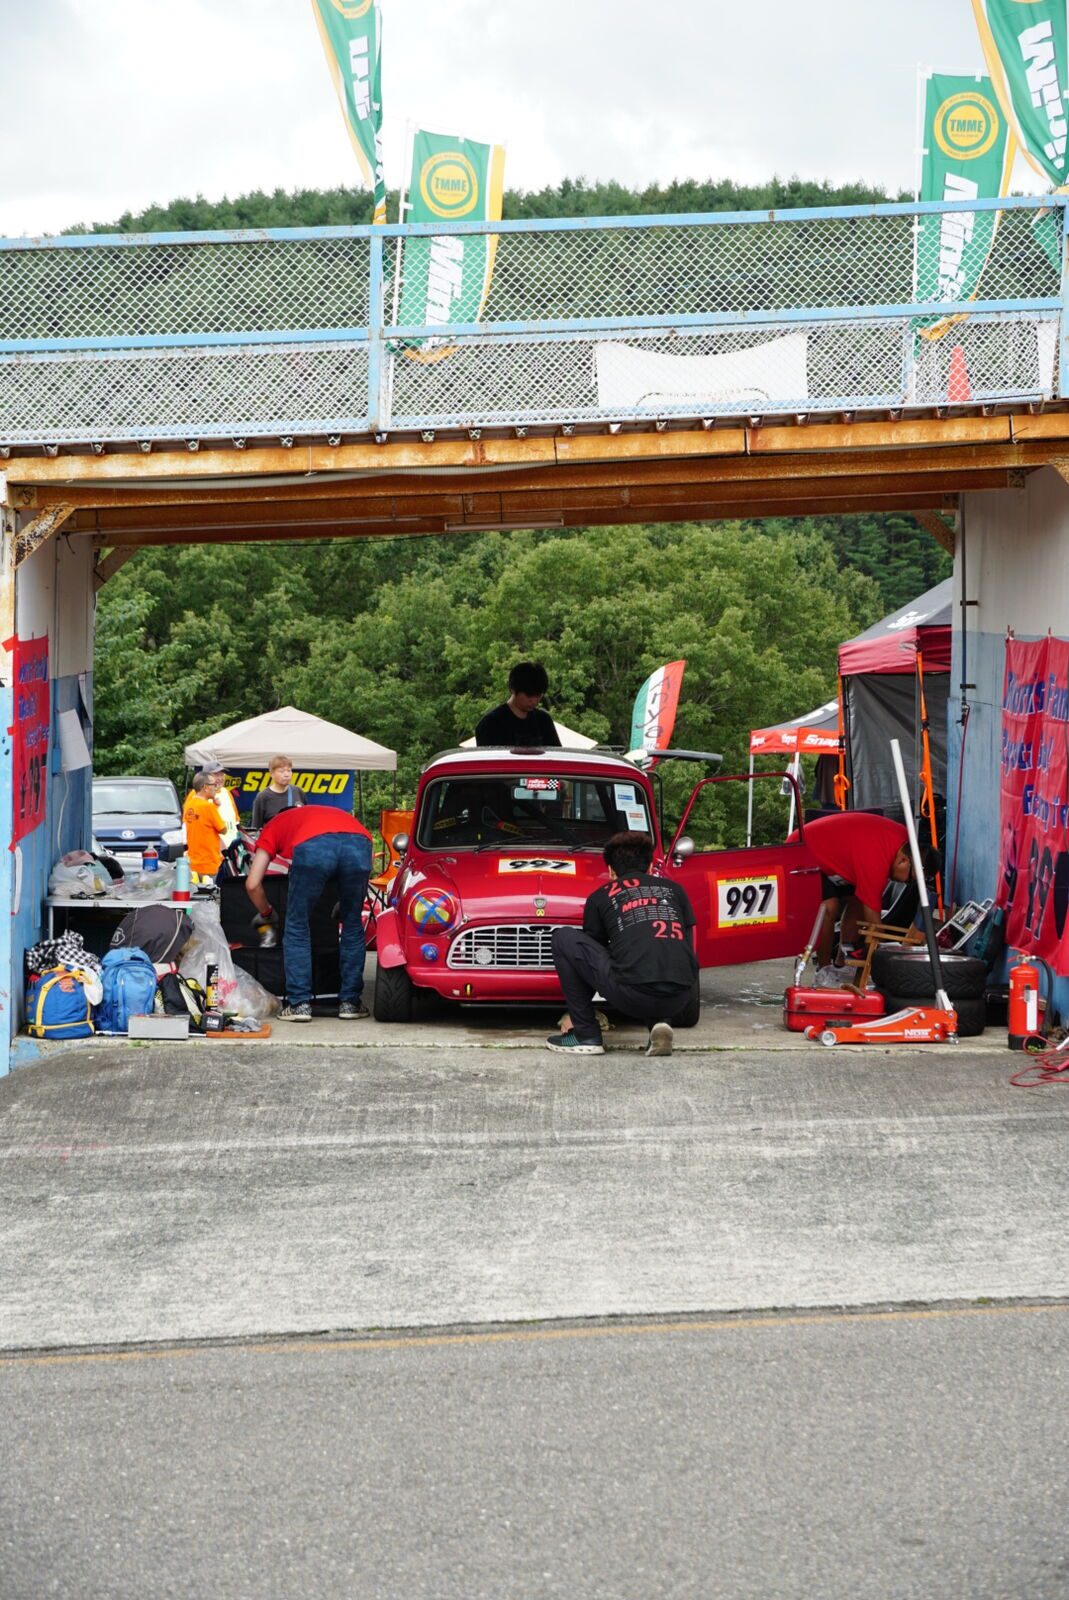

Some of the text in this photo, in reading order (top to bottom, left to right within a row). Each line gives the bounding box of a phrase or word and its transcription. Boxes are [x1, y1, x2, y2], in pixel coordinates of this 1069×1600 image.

[951, 119, 984, 133] TMME
[435, 176, 466, 192] TMME
[243, 772, 349, 794] SUOCO
[509, 860, 571, 870] 997
[726, 884, 773, 917] 997
[652, 920, 683, 940] 25
